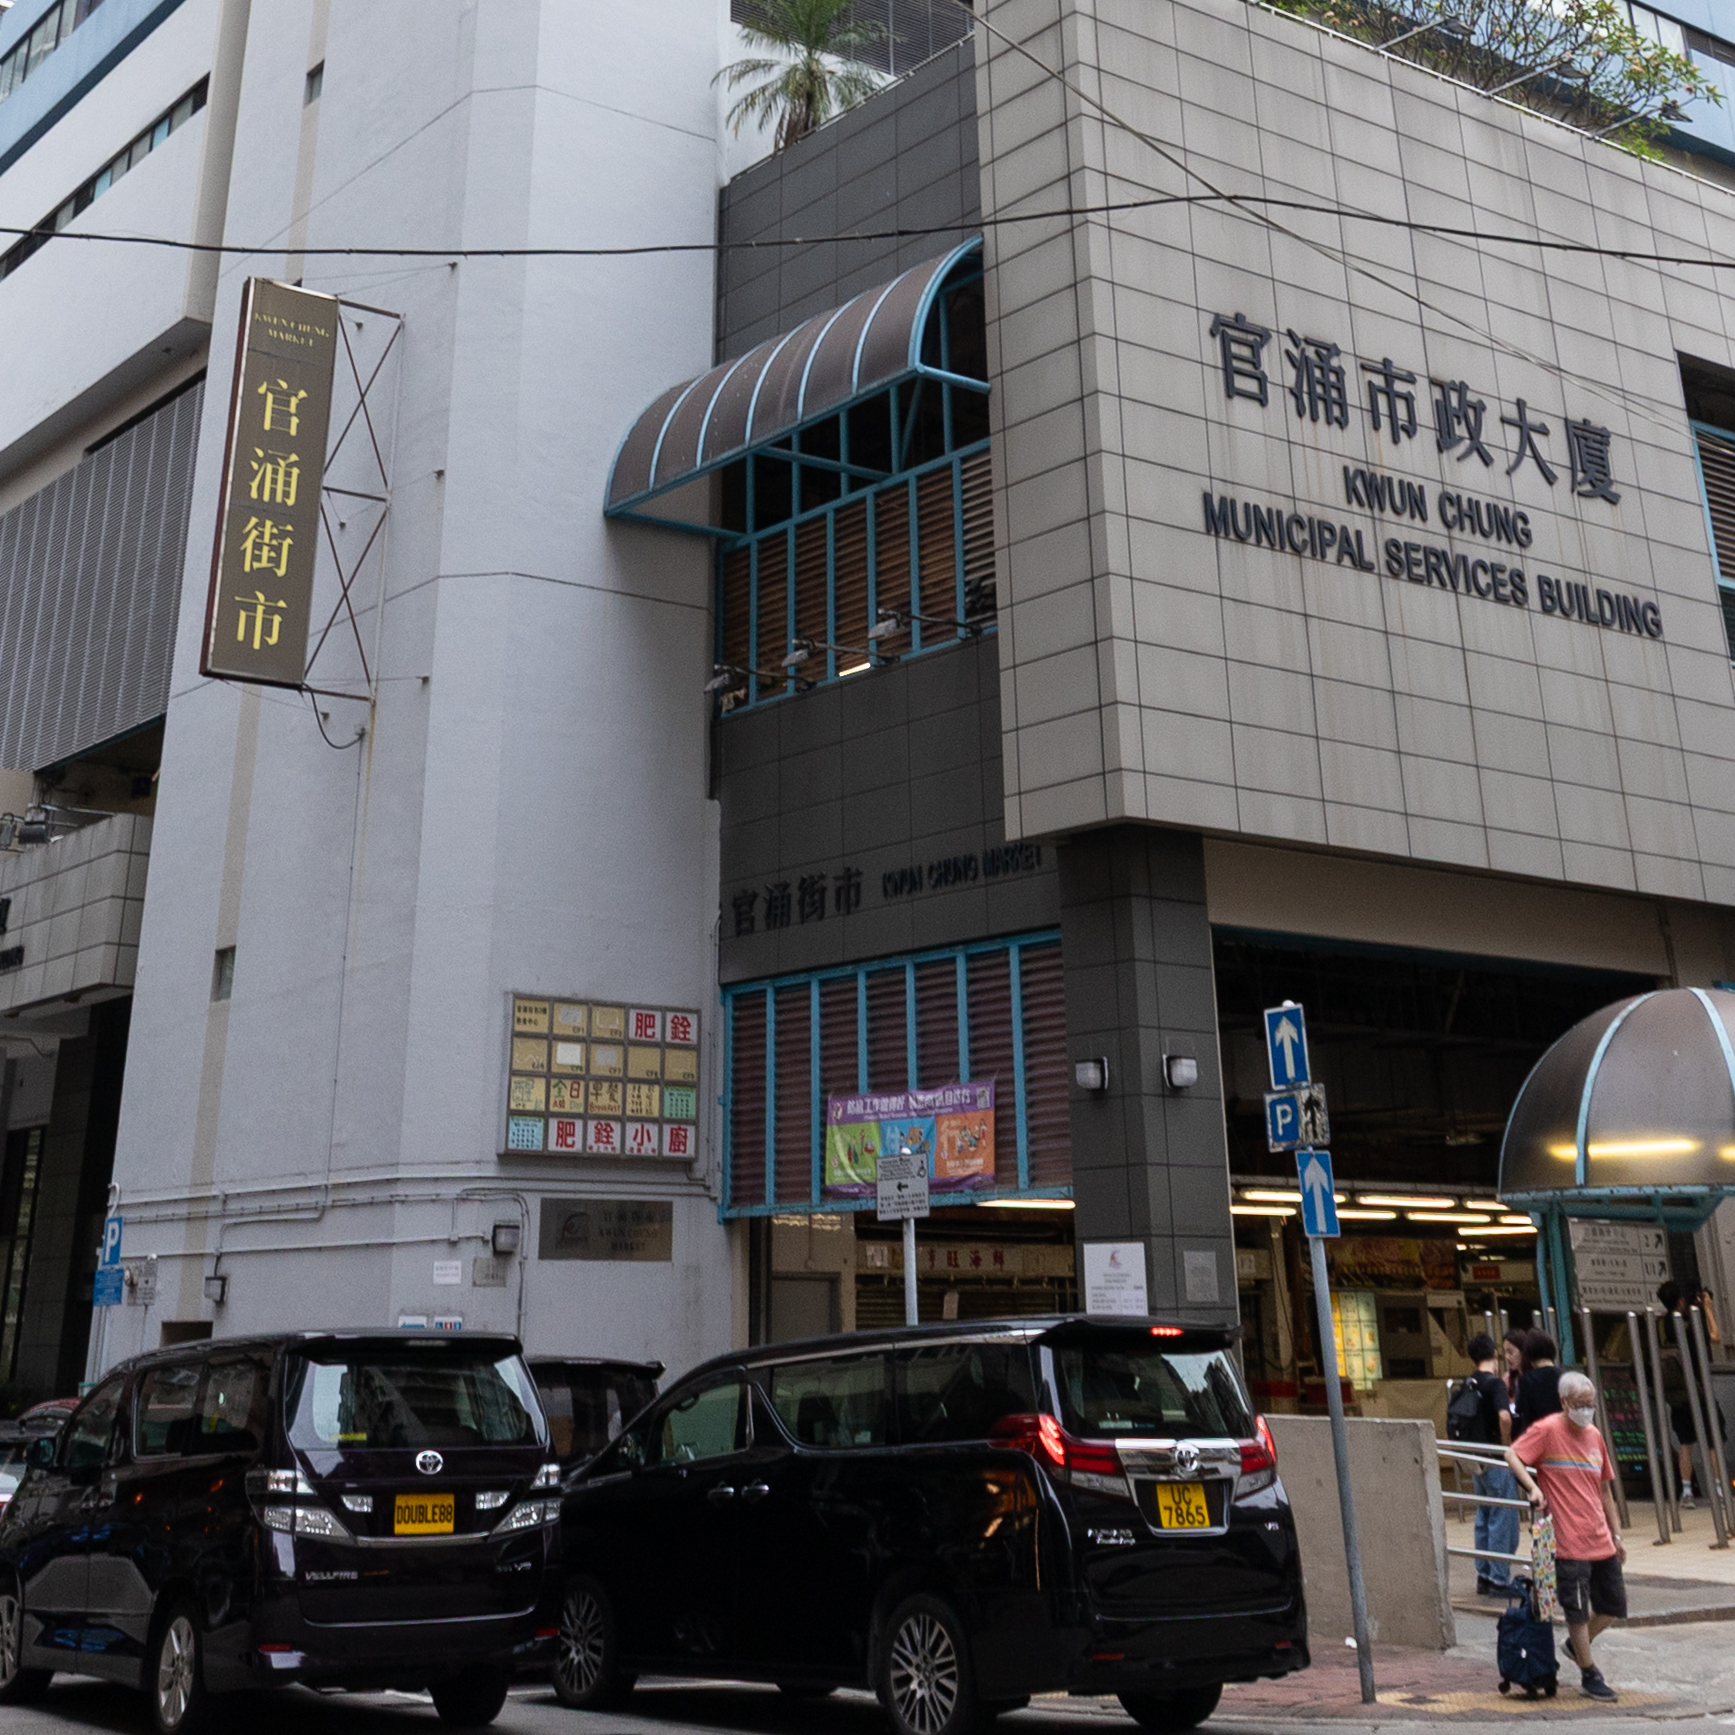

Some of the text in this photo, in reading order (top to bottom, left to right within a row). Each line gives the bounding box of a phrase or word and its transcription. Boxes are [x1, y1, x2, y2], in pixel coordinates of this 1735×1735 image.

[255, 312, 329, 338] KWUN CHUNG
[268, 328, 313, 347] MARKET
[1210, 312, 1623, 505] 官涌市政大廈
[234, 378, 308, 651] 官涌街市
[1343, 465, 1532, 549] KWUN CHUNG
[1203, 492, 1663, 639] MUNICIPAL SERVICES BUILDING
[881, 842, 1042, 900] KWUN CHUNG MARKET
[732, 866, 863, 938] 官涌街市
[1275, 1104, 1293, 1136] P
[105, 1222, 119, 1263] P
[1170, 1486, 1193, 1506] UC
[396, 1504, 454, 1525] DOUBLE88
[1163, 1506, 1206, 1526] 7865
[305, 1571, 359, 1581] VELLFIRE
